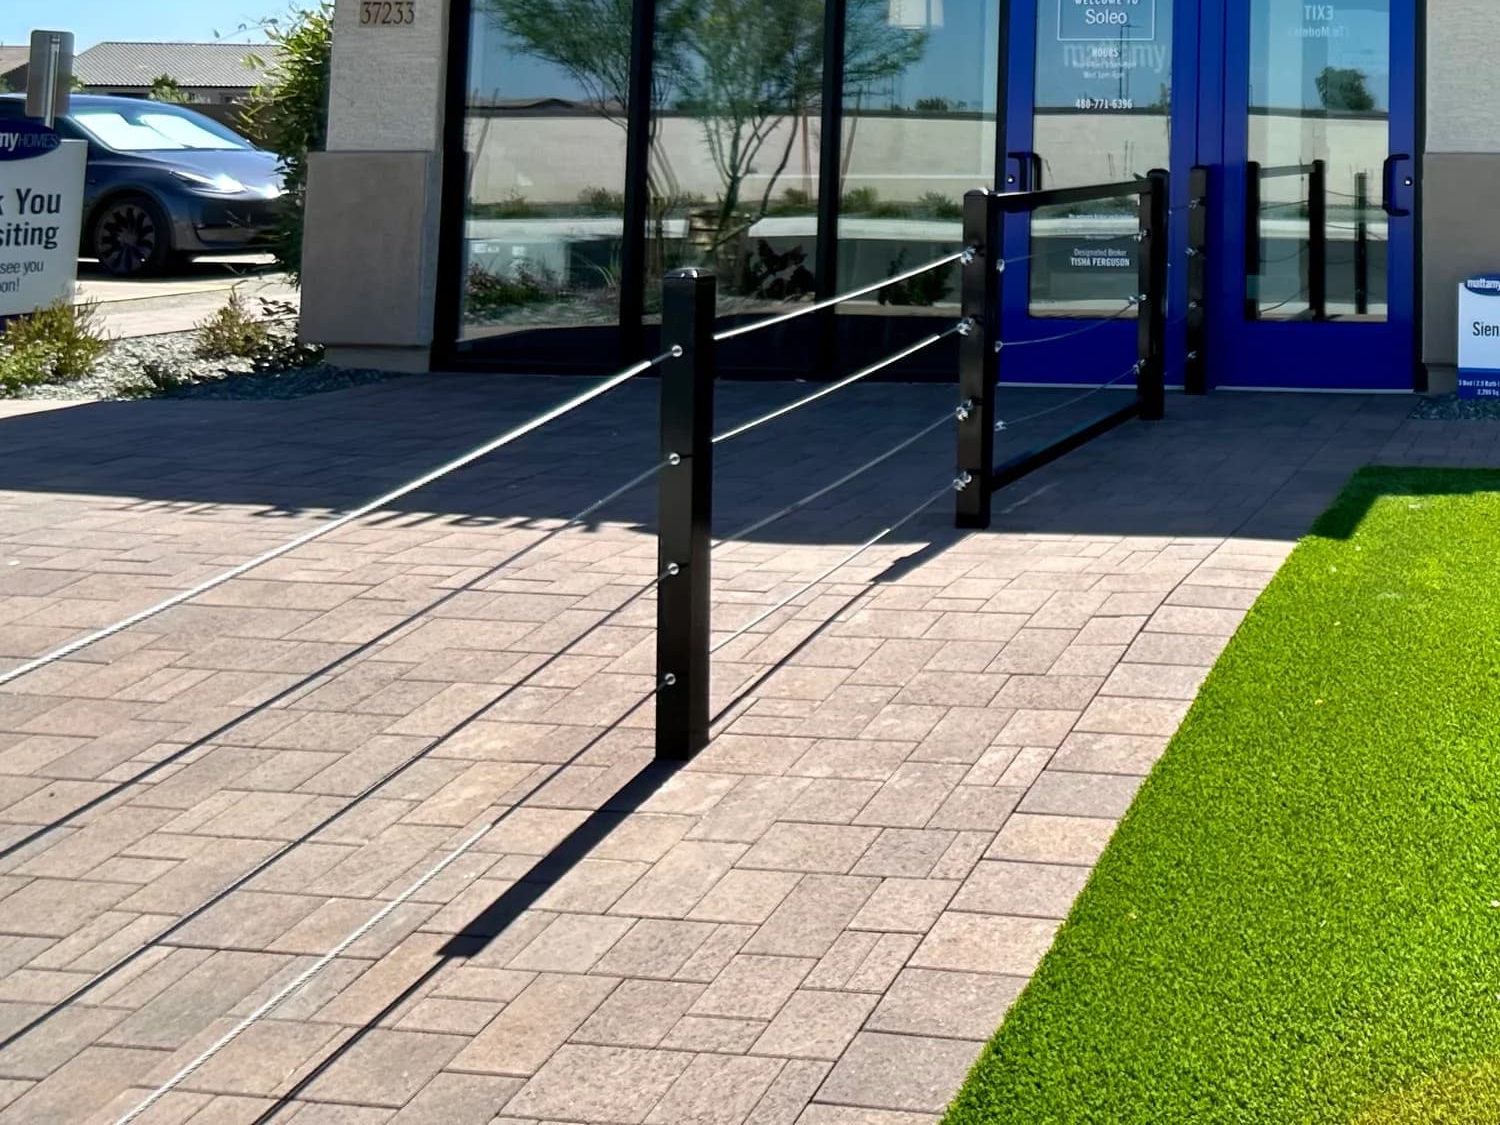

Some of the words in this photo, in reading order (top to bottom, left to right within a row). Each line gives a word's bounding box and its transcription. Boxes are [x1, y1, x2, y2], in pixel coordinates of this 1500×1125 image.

[360, 1, 415, 25] 37233
[1085, 8, 1128, 24] Soleo
[15, 187, 61, 215] You
[23, 259, 44, 276] you
[1092, 257, 1130, 267] FERGUSON
